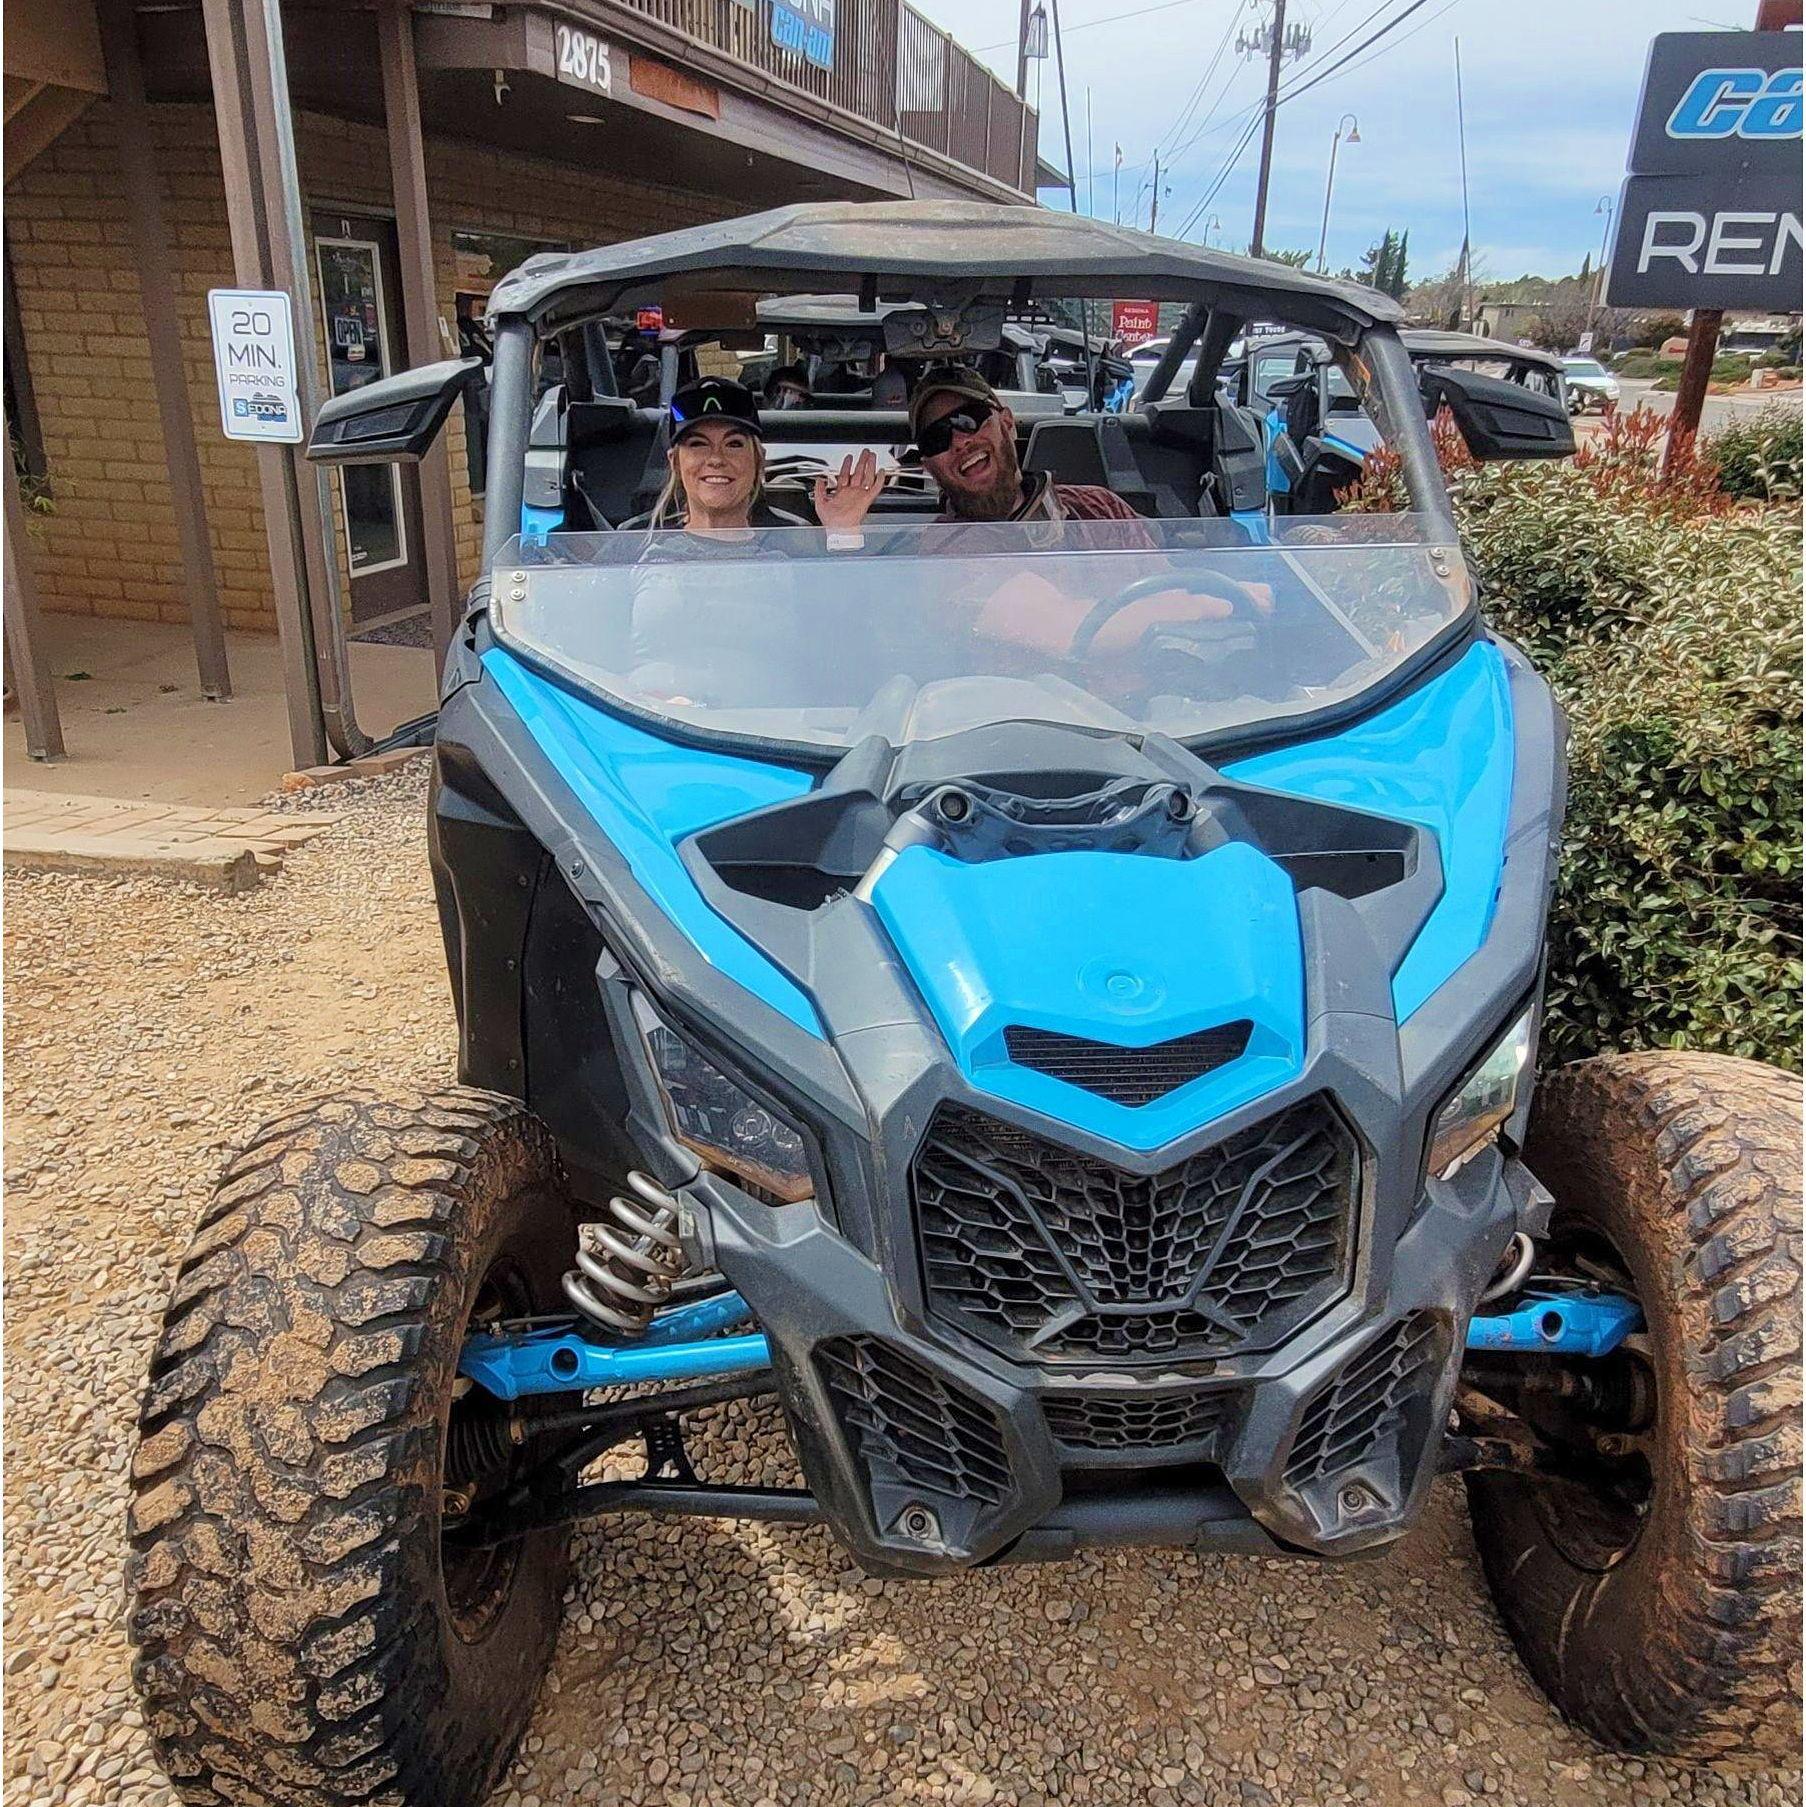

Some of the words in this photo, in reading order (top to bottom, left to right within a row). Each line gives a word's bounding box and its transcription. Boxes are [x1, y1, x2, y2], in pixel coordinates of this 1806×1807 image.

[557, 25, 612, 90] 2875
[231, 311, 271, 336] 20
[337, 319, 362, 345] OPEN
[1118, 315, 1153, 329] Paint
[1115, 329, 1155, 343] Center
[228, 342, 282, 369] MIN.
[229, 373, 285, 388] PARKING
[234, 400, 288, 416] SEDONA
